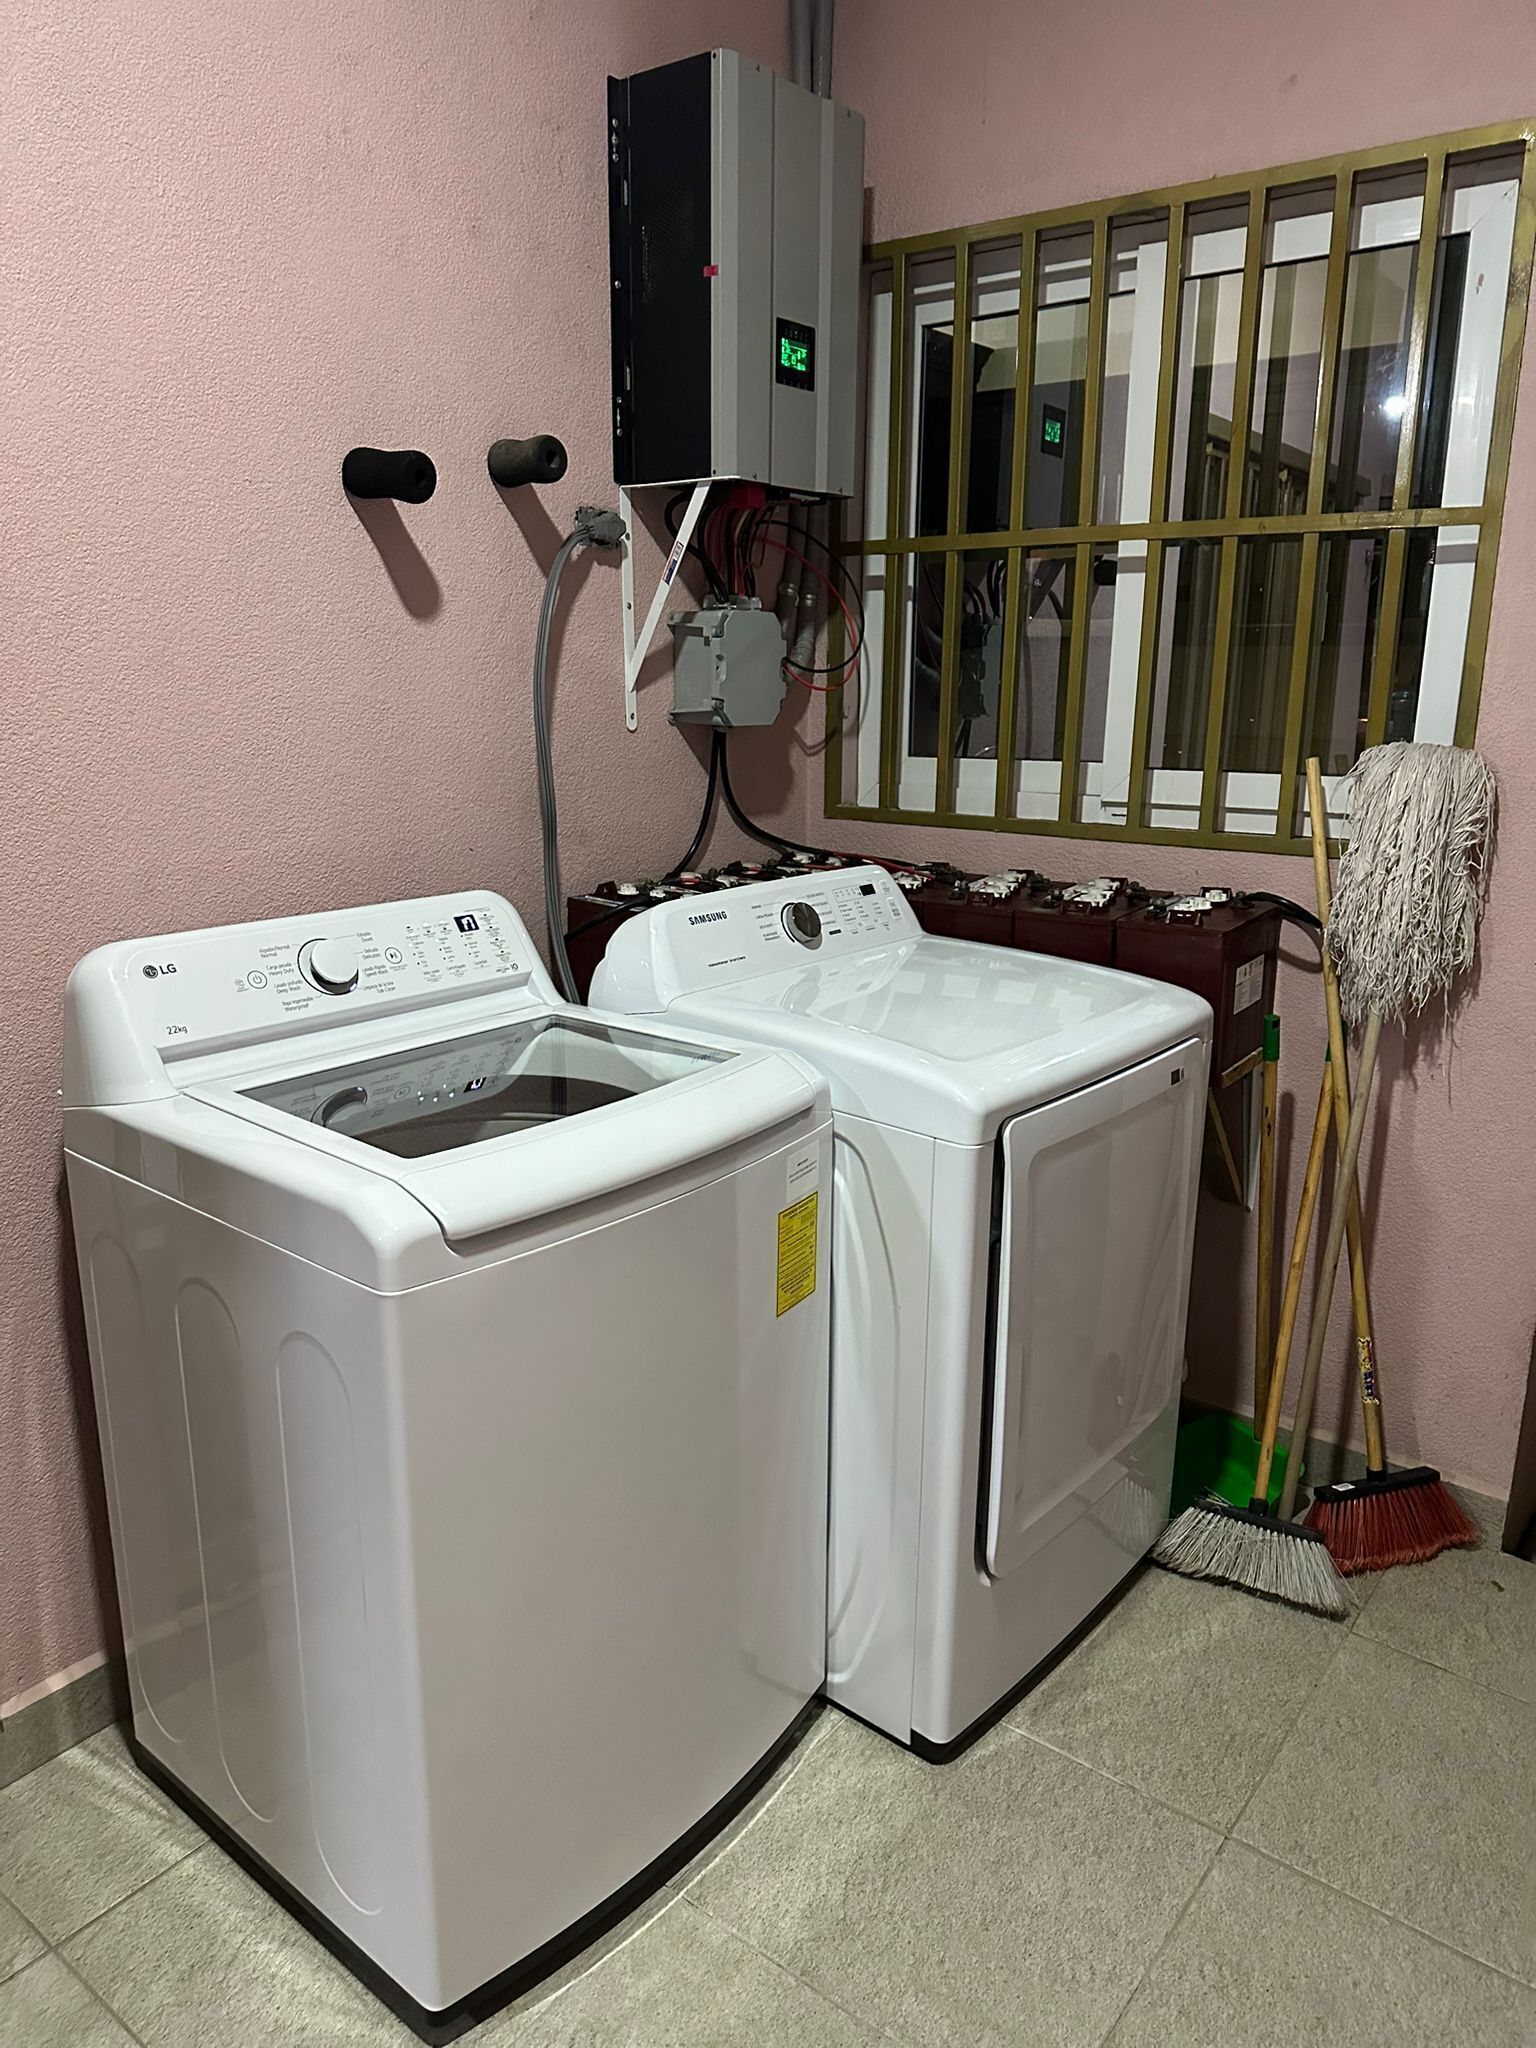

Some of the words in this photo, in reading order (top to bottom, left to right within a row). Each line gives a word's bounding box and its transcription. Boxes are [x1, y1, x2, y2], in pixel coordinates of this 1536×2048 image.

[688, 911, 728, 926] SAMSUNG
[159, 963, 177, 975] LG
[166, 1025, 189, 1035] 22kg
